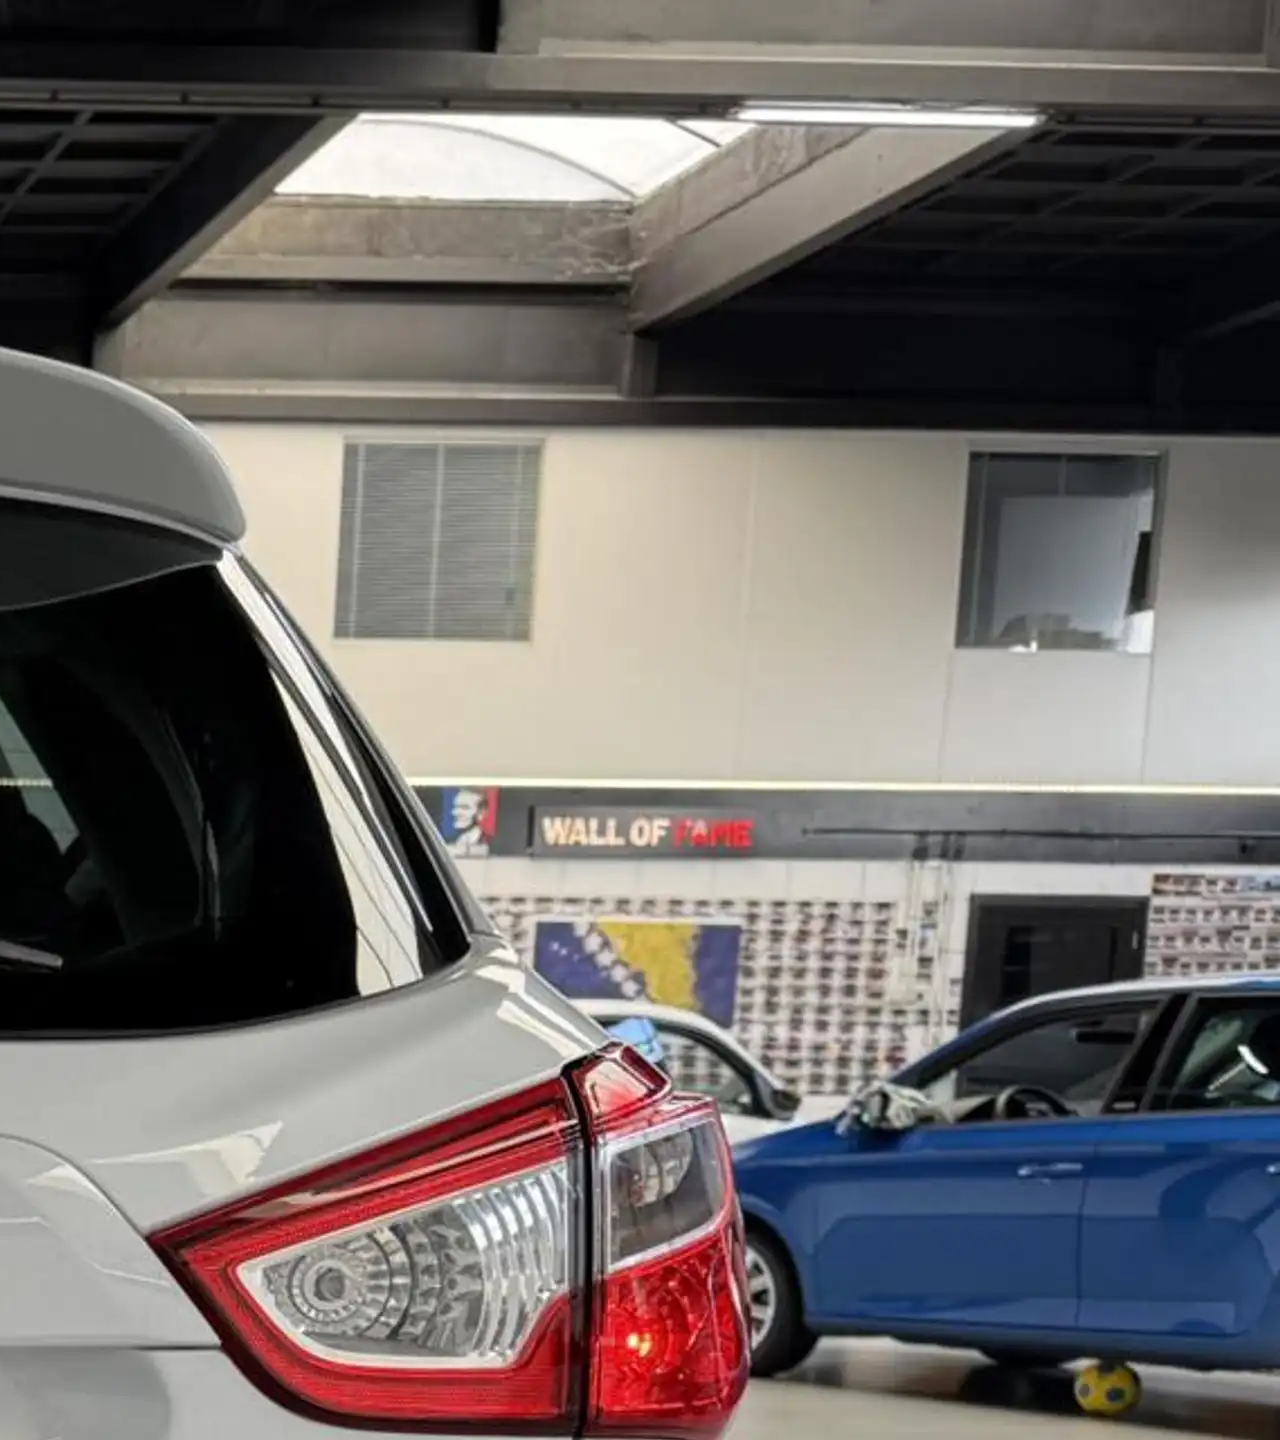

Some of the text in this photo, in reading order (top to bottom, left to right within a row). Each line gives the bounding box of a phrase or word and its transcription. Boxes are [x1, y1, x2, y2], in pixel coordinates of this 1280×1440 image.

[542, 816, 754, 848] WALL OF FAME
